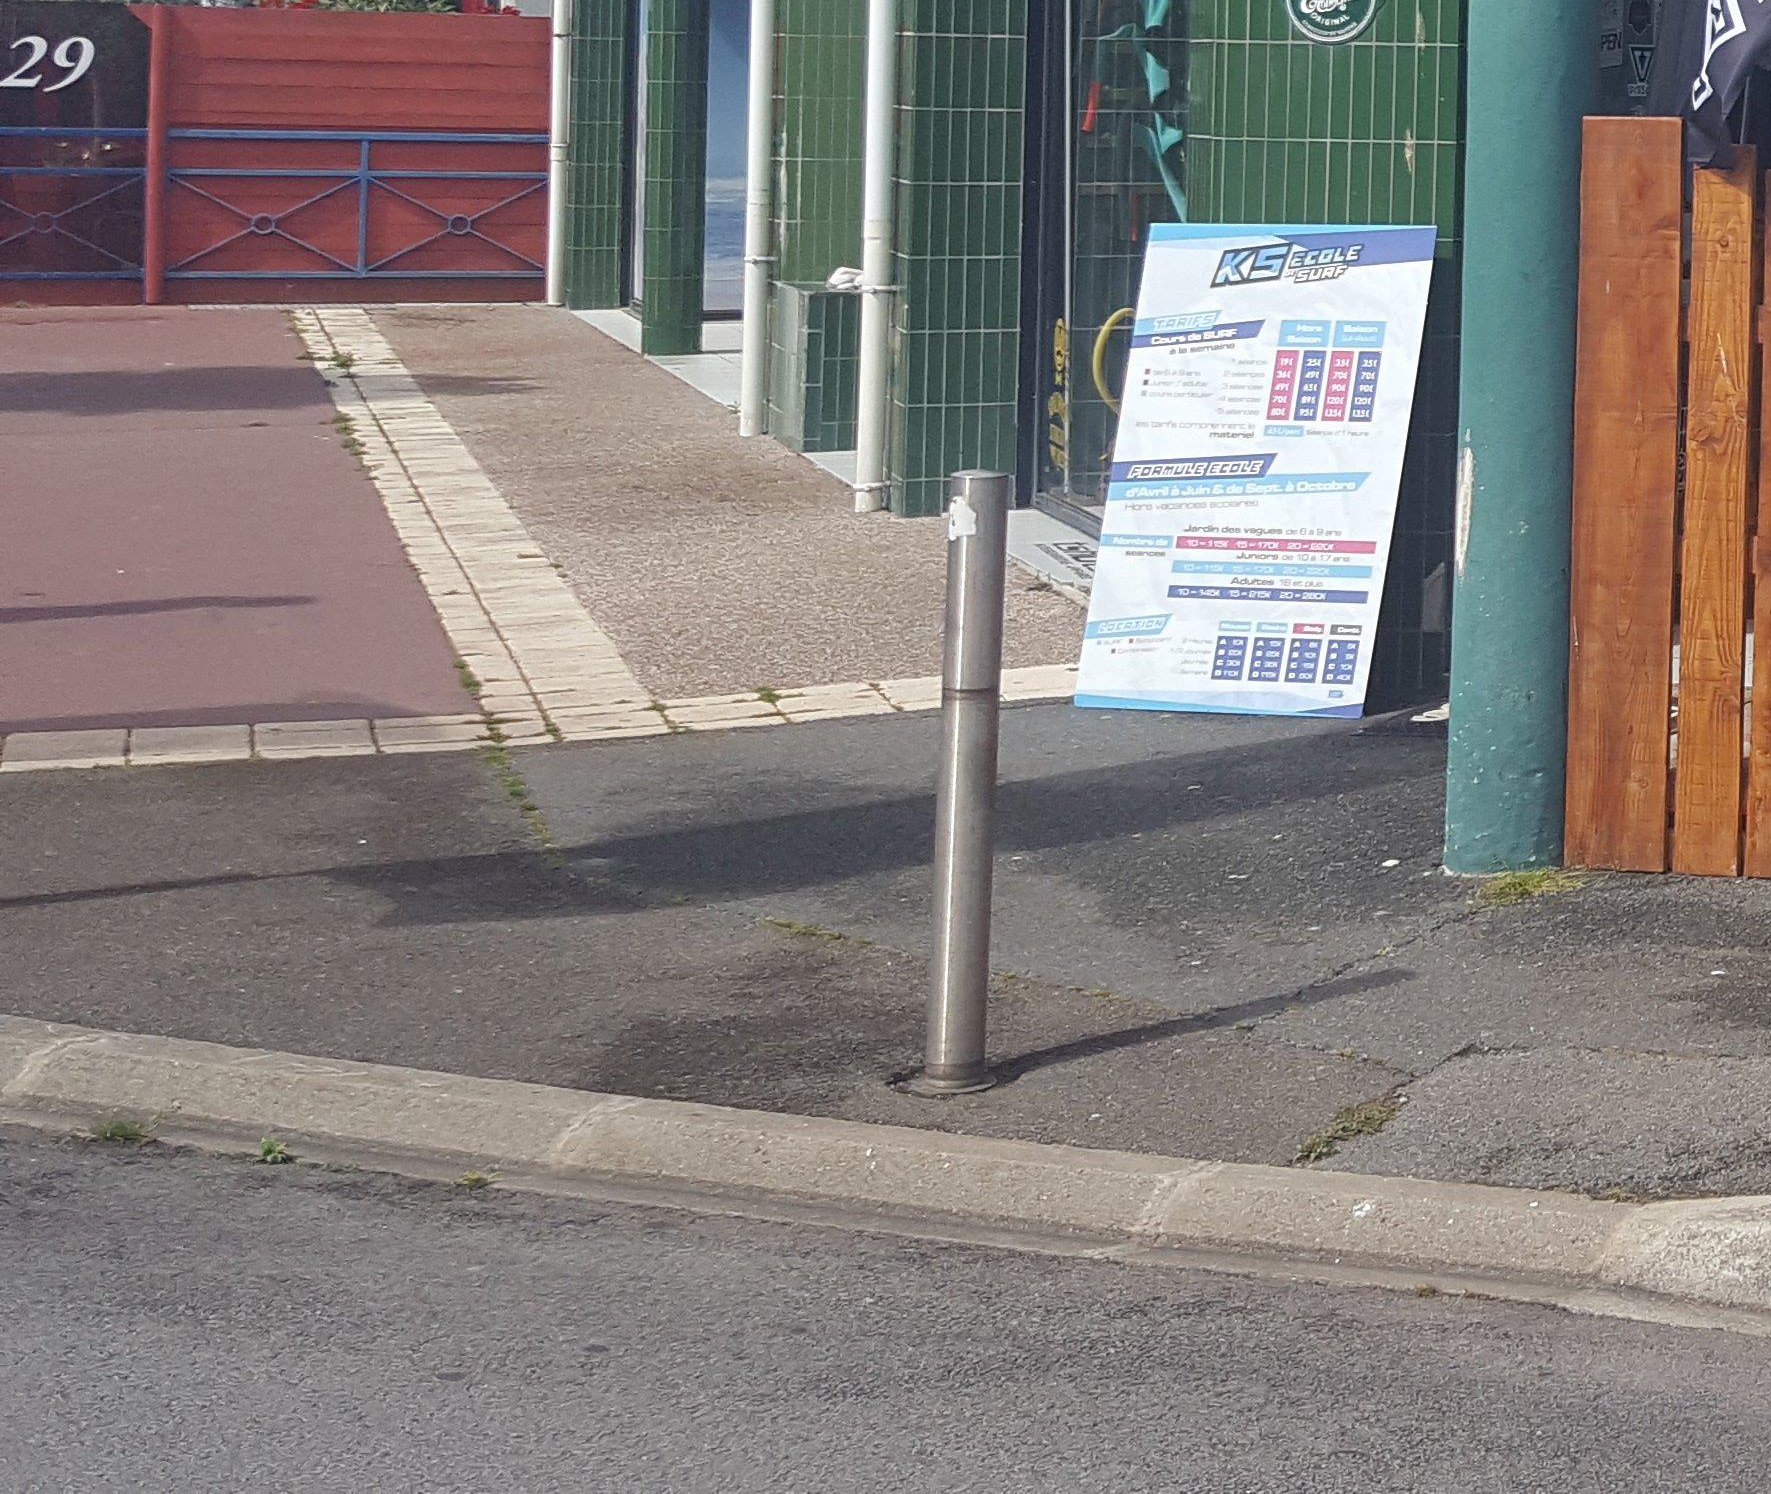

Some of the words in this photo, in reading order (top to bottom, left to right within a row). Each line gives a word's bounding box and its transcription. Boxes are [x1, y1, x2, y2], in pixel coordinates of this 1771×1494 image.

[0, 36, 95, 92] 29
[1291, 244, 1363, 268] ECOLE
[1295, 265, 1348, 283] SURF
[1154, 312, 1216, 331] TARIFS
[1151, 334, 1185, 346] Cours
[1203, 329, 1237, 340] SURF
[1128, 462, 1203, 479] FORMULE
[1207, 460, 1263, 476] ECOLE
[1126, 483, 1169, 498] d'Avril
[1182, 484, 1210, 496] Juin
[1227, 483, 1243, 494] de
[1296, 480, 1356, 492] Octobre
[1183, 524, 1220, 534] Jardin
[1222, 525, 1241, 533] des
[1243, 527, 1283, 536] vagues
[1236, 552, 1279, 560] Juniors
[1230, 577, 1274, 585] Adultes
